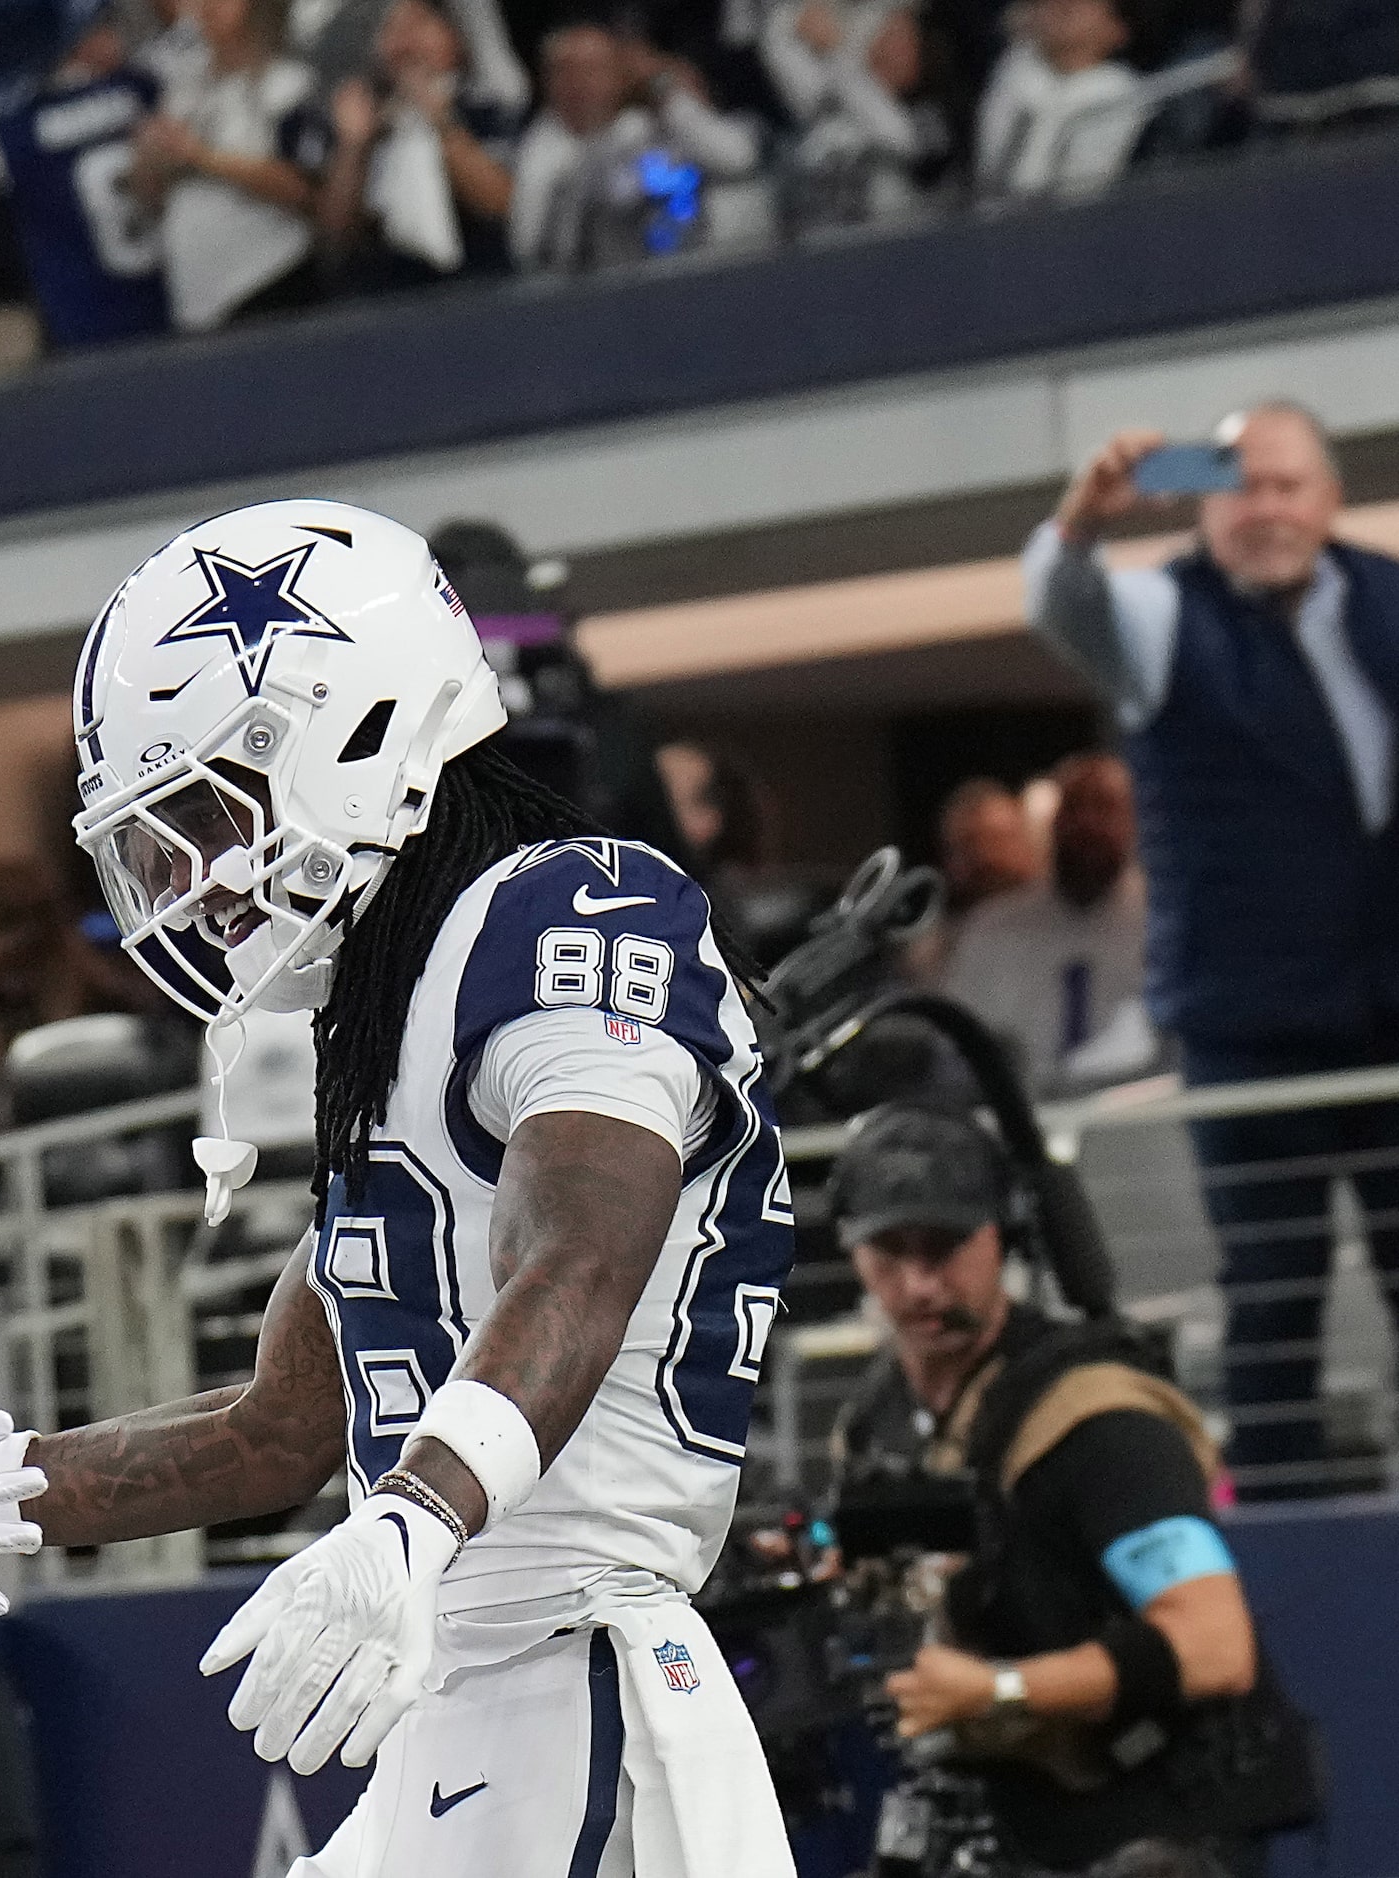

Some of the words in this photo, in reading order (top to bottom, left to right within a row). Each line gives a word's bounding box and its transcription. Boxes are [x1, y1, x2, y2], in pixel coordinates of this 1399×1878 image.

[534, 927, 675, 1025] 88
[608, 1020, 638, 1041] NFL
[664, 1663, 698, 1688] NFL
